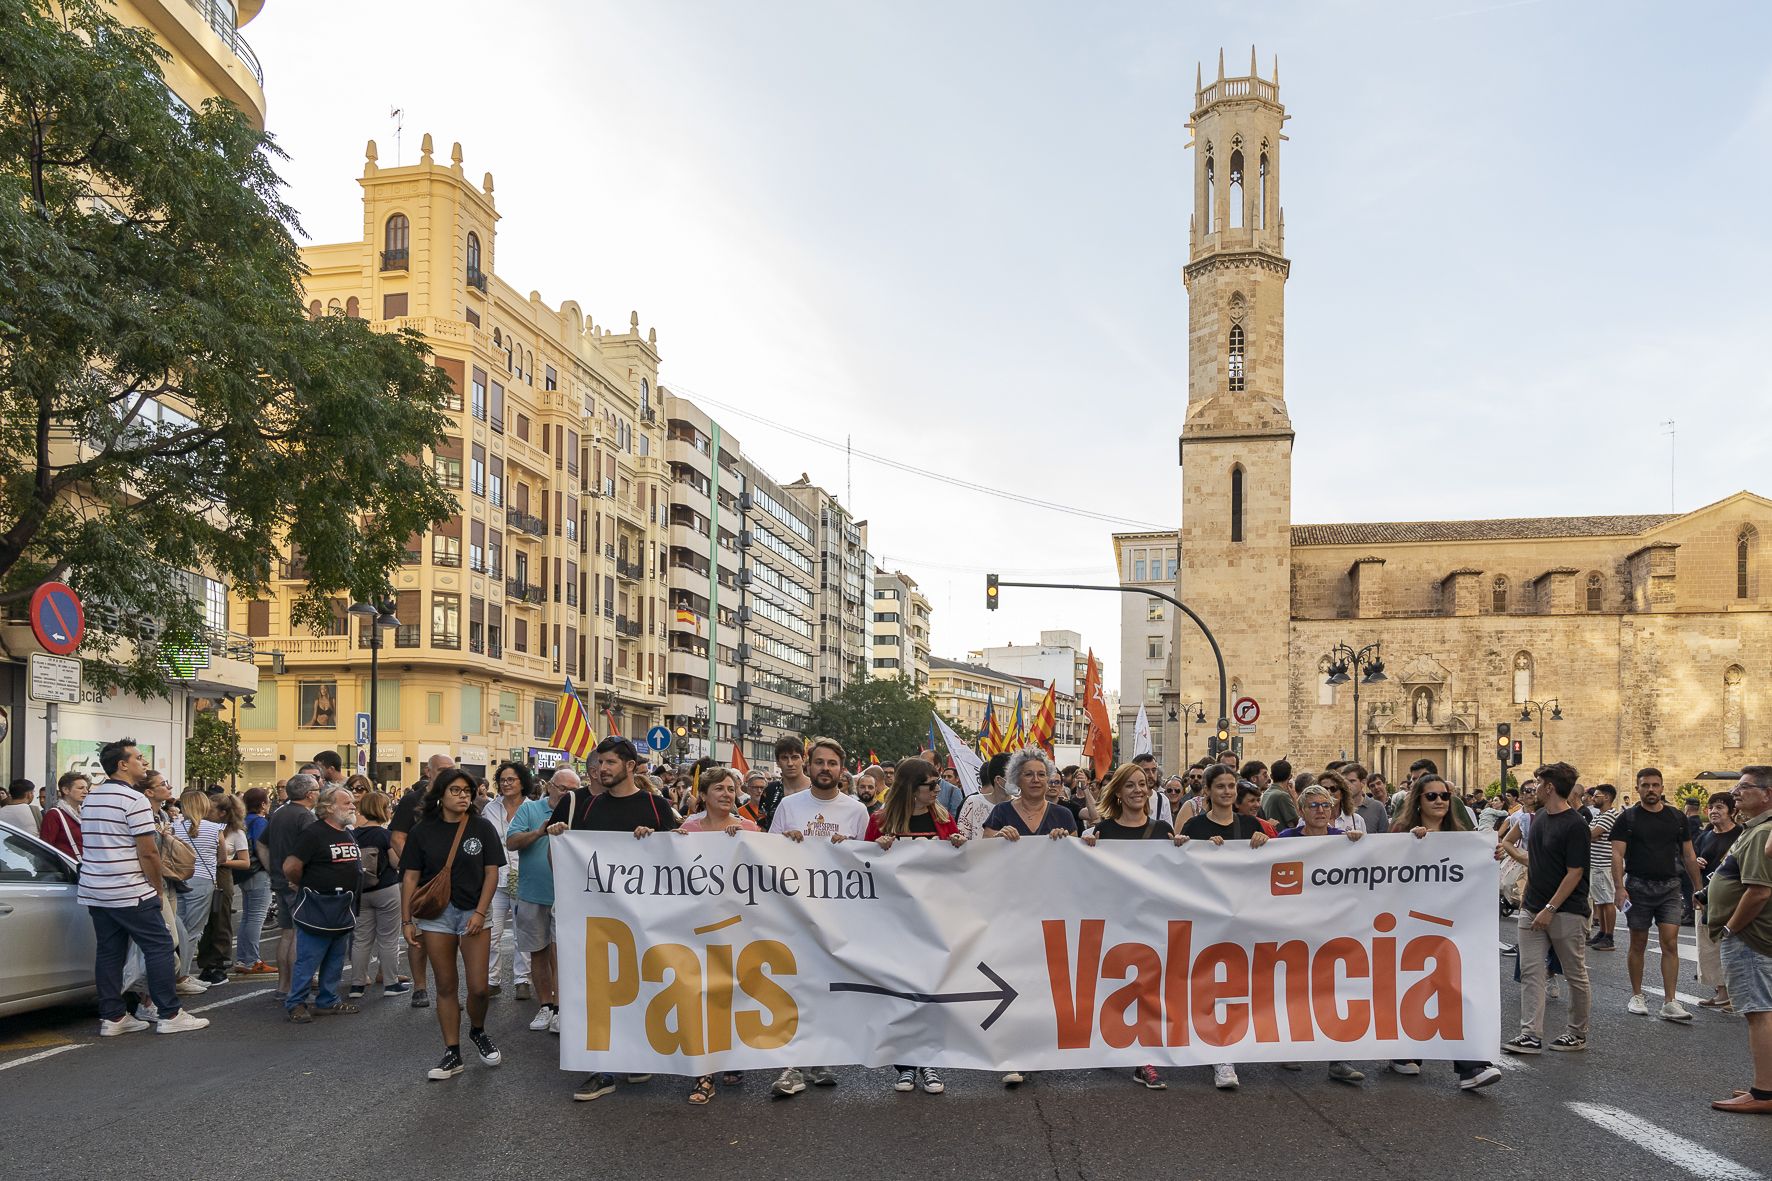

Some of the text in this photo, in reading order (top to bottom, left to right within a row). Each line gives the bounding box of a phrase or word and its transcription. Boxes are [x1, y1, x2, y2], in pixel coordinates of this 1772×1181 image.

[537, 751, 562, 761] TATTOO
[538, 760, 556, 769] STUD
[584, 851, 880, 906] Ara més que mai
[1311, 857, 1464, 890] compromís
[585, 910, 1464, 1057] País Valencià
